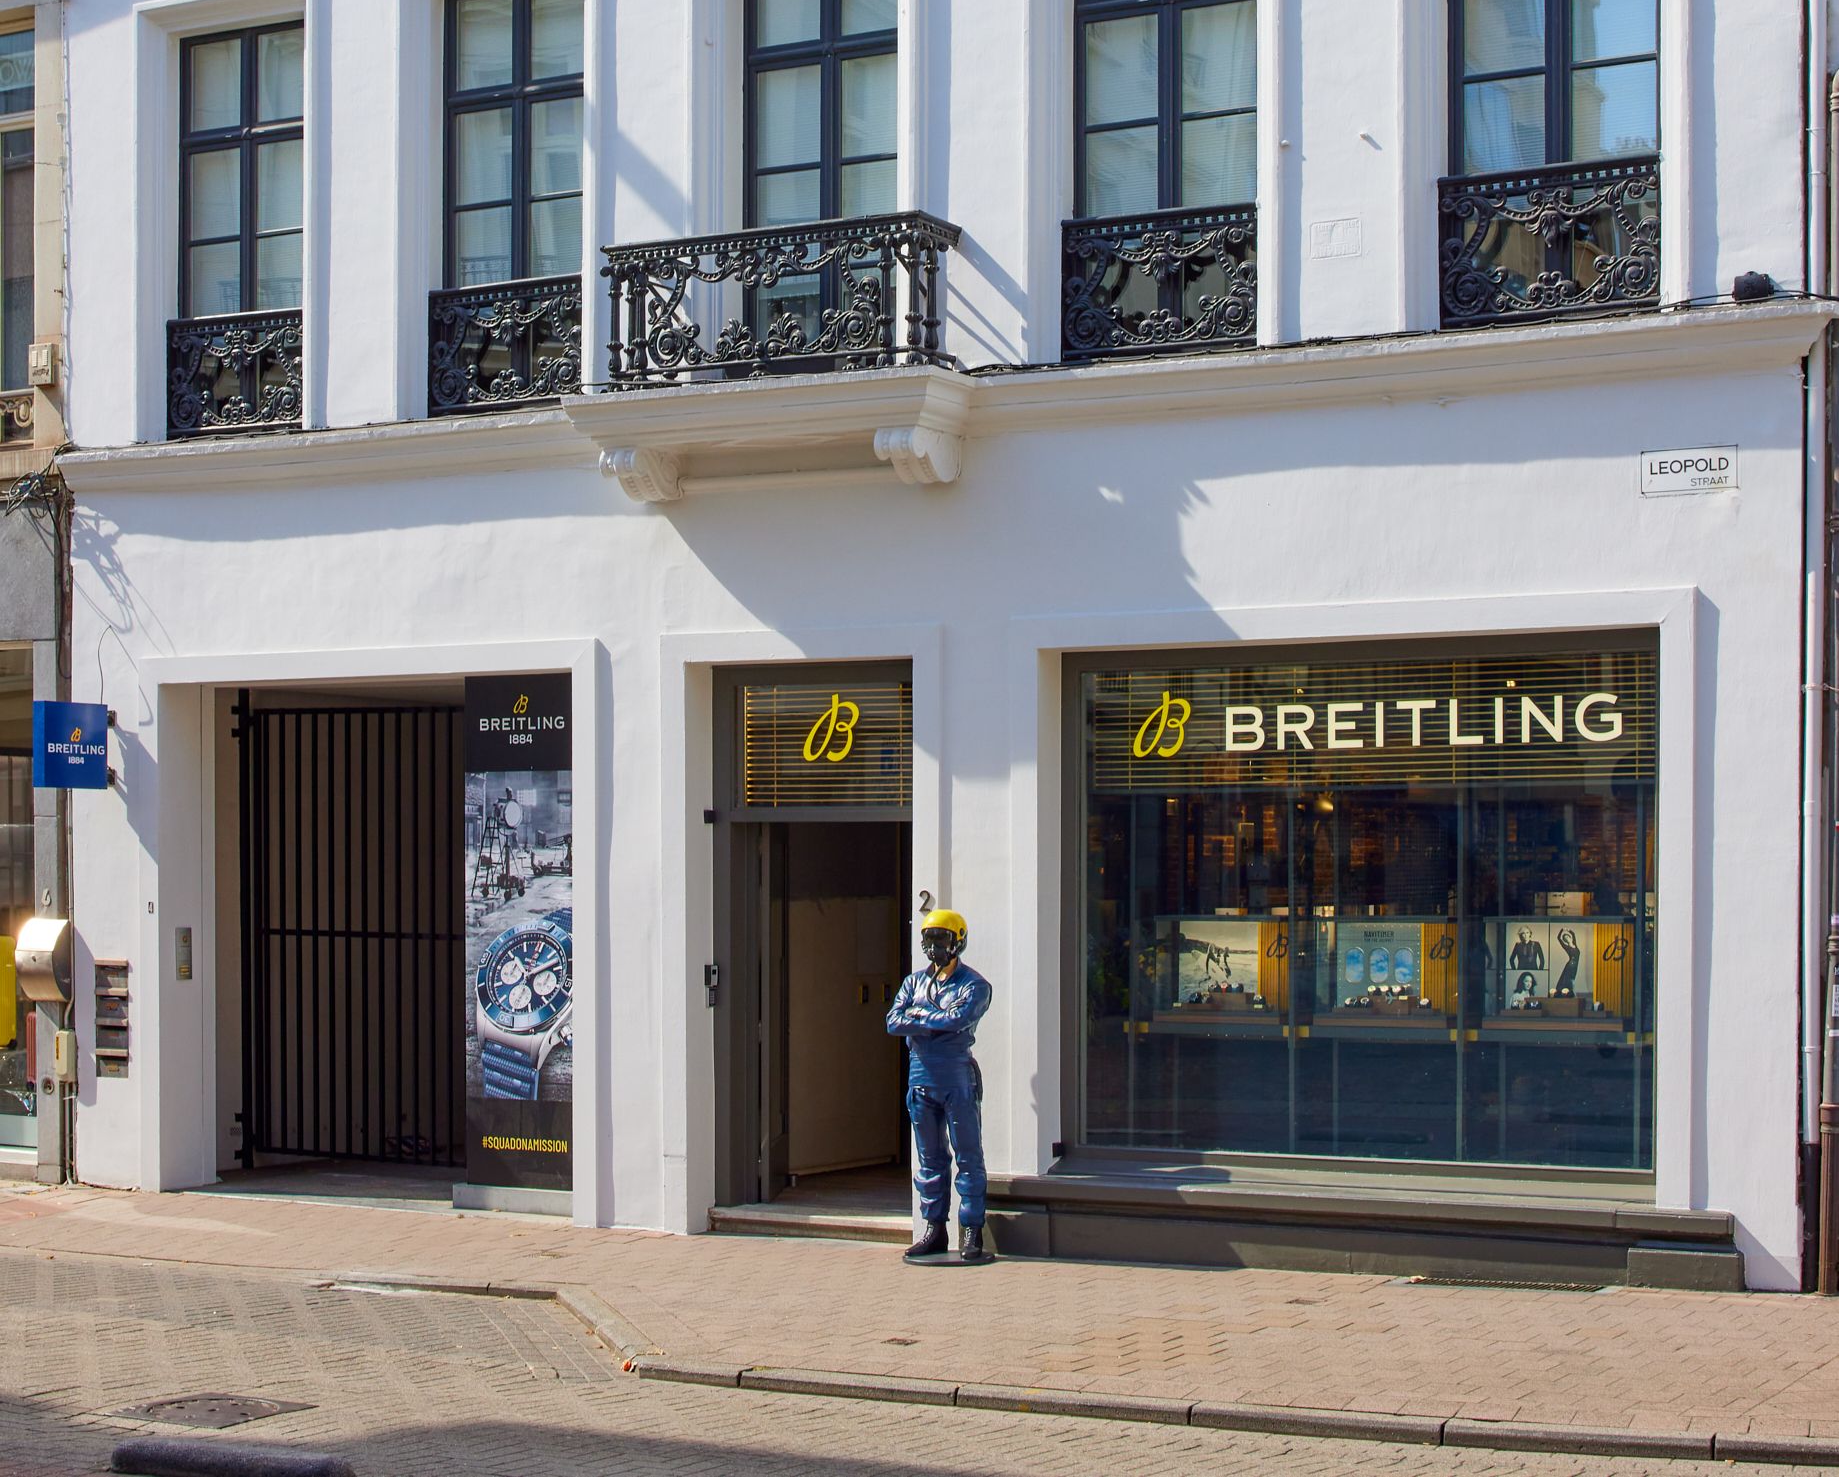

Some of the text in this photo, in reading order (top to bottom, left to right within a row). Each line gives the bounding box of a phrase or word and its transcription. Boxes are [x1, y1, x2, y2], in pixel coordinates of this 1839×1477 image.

[1650, 457, 1729, 475] LEOPOLD
[1690, 476, 1729, 487] STRAAT
[480, 716, 565, 731] BREITLING
[1225, 692, 1623, 751] BREITLING
[509, 733, 533, 744] 1884
[47, 743, 106, 755] BREITLING
[68, 756, 85, 764] 1884
[41, 887, 52, 907] 6
[919, 890, 932, 912] 2
[482, 1135, 568, 1153] #SQUADONAMISSION
